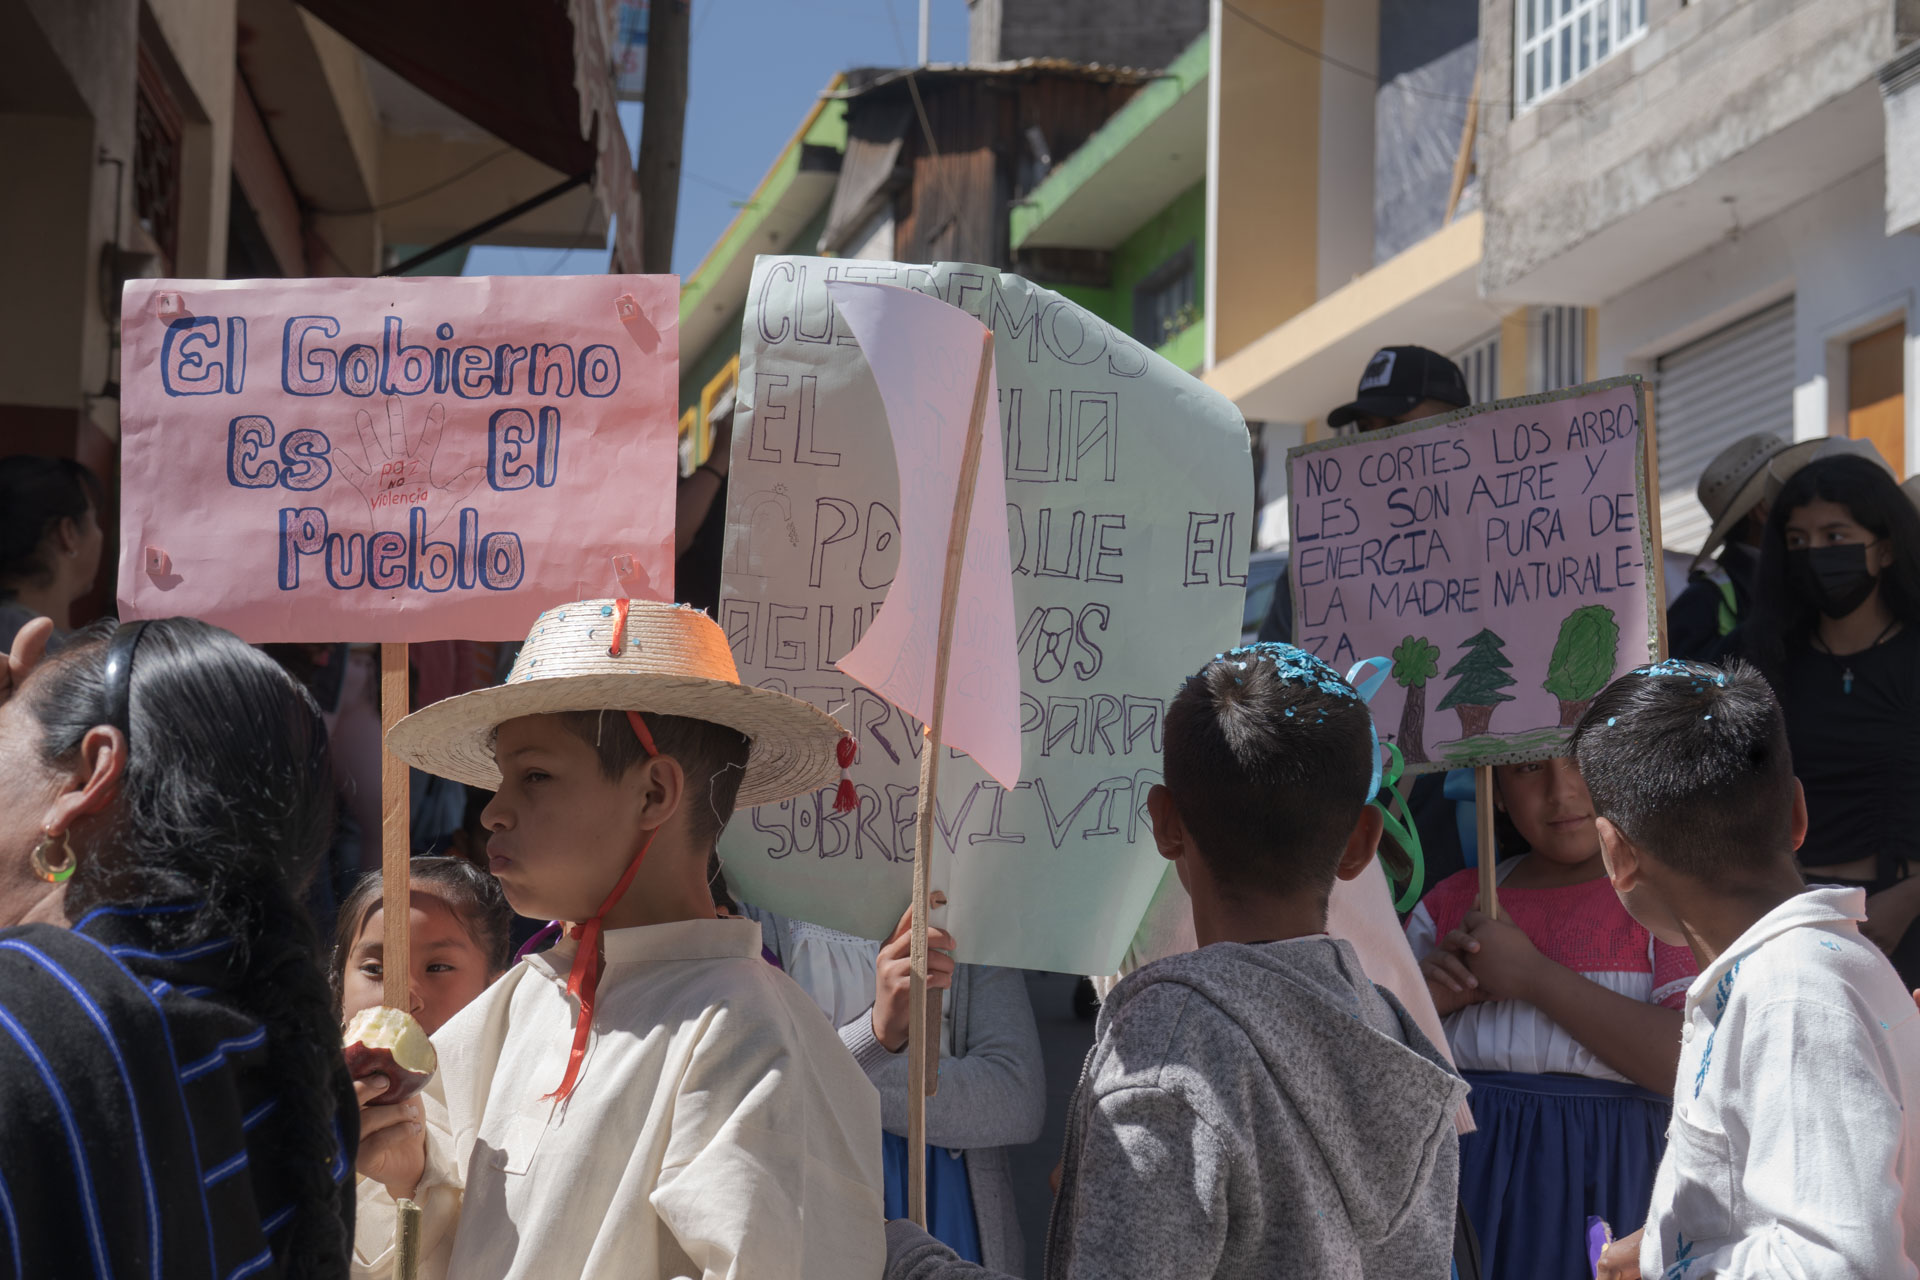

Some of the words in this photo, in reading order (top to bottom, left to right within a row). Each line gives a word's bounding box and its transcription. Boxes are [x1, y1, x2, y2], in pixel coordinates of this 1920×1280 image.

[161, 316, 247, 397] El
[281, 315, 621, 399] Gobierno
[757, 261, 1149, 378] CUEMOS
[227, 414, 333, 492] Es
[487, 405, 561, 491] El
[748, 372, 841, 466] EL
[997, 388, 1118, 483] UA
[1306, 457, 1342, 498] NO
[1359, 438, 1471, 487] CORTES
[1492, 422, 1551, 464] LOS
[370, 487, 428, 511] violencia
[379, 459, 420, 488] paz
[387, 477, 405, 489] NO
[1296, 498, 1360, 543] LES
[1386, 480, 1450, 529] SON
[1467, 460, 1560, 515] AIRE
[1581, 449, 1608, 494] Y
[278, 506, 525, 593] Pueblo
[1183, 511, 1248, 588] EL
[1299, 529, 1451, 588] ENERGIA
[1486, 506, 1566, 563] PURA
[1589, 493, 1635, 537] DE
[720, 598, 885, 675] AGU
[1302, 586, 1348, 628] LA
[1369, 576, 1480, 620] MADRE
